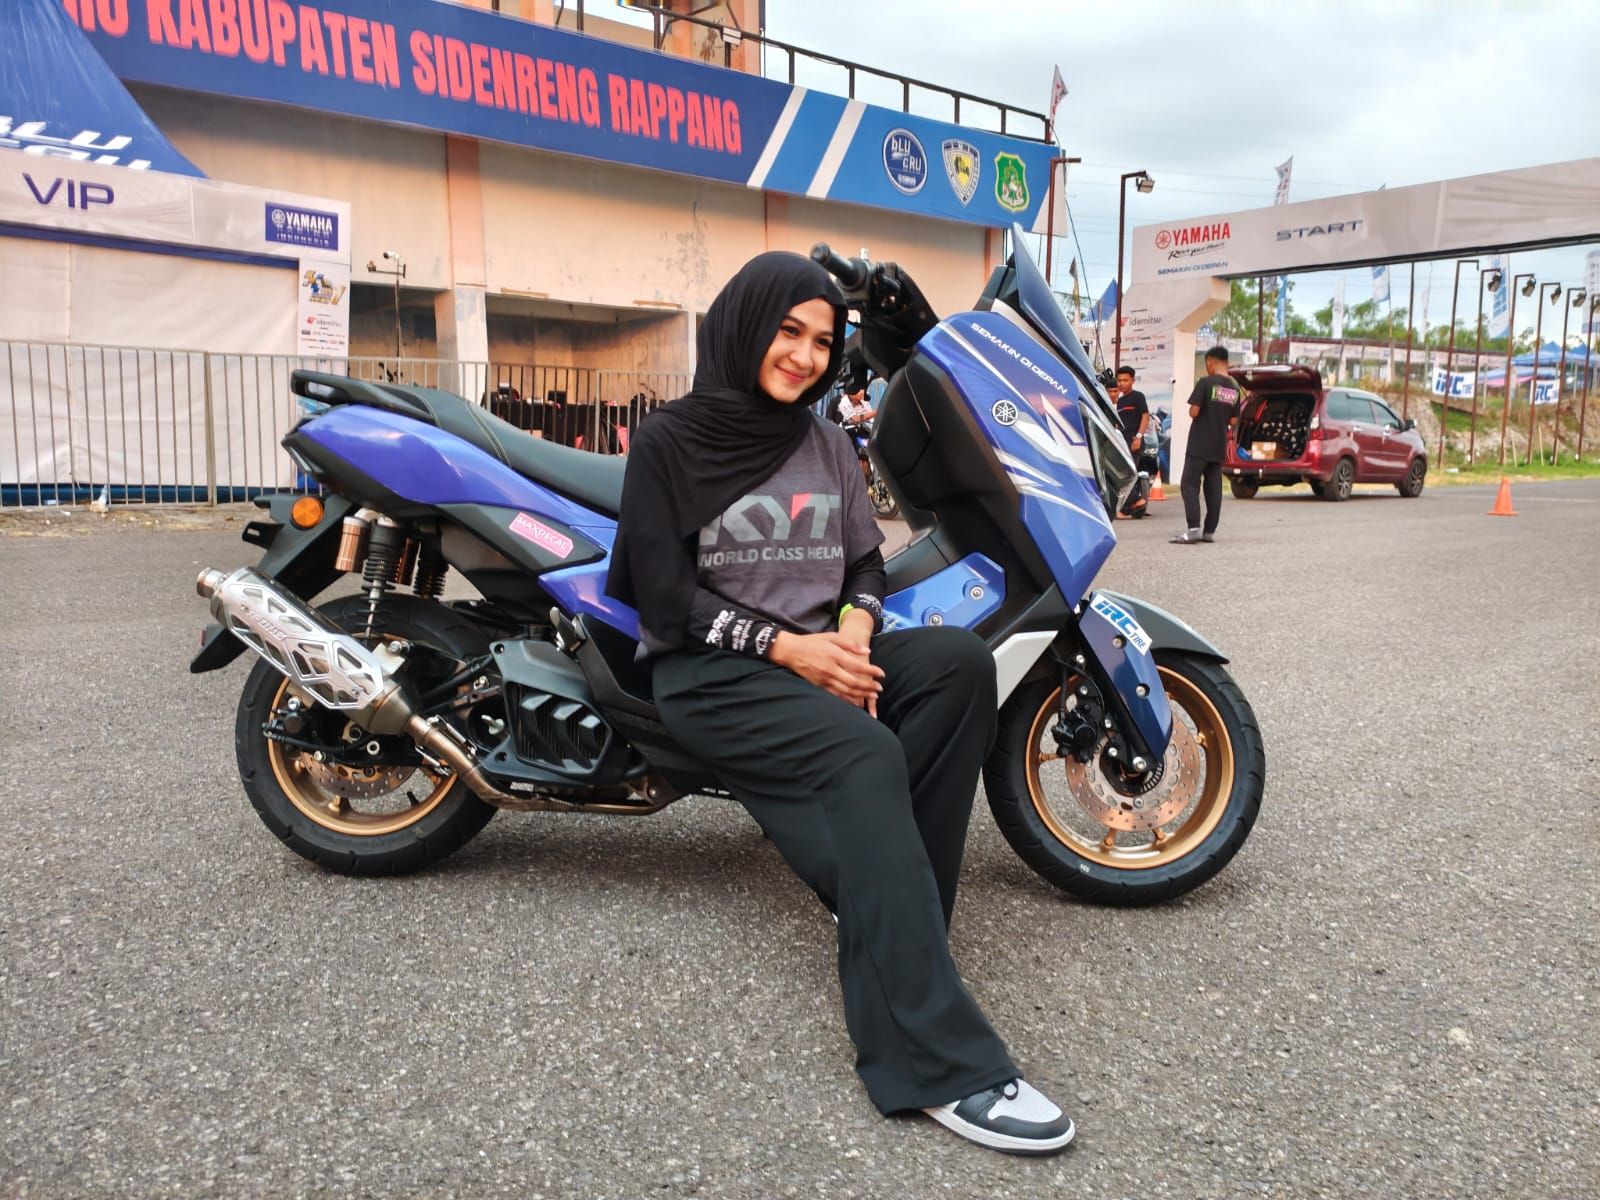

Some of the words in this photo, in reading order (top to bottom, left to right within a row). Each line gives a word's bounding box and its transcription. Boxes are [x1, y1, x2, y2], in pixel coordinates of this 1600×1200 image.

[146, 0, 400, 89] KABUPATEN
[409, 30, 601, 128] SIDENRENG
[608, 73, 742, 155] RAPPANG
[22, 172, 115, 210] VIP
[286, 211, 333, 233] YAMAHA
[1276, 220, 1364, 241] START
[1172, 222, 1231, 246] YAMAHA
[1129, 316, 1162, 326] idemitsu
[970, 323, 1021, 360] SEMAKIN
[1020, 355, 1033, 369] DI
[1031, 365, 1069, 395] DEPAN
[698, 549, 759, 568] WORLD
[1130, 632, 1147, 649] TIRE
